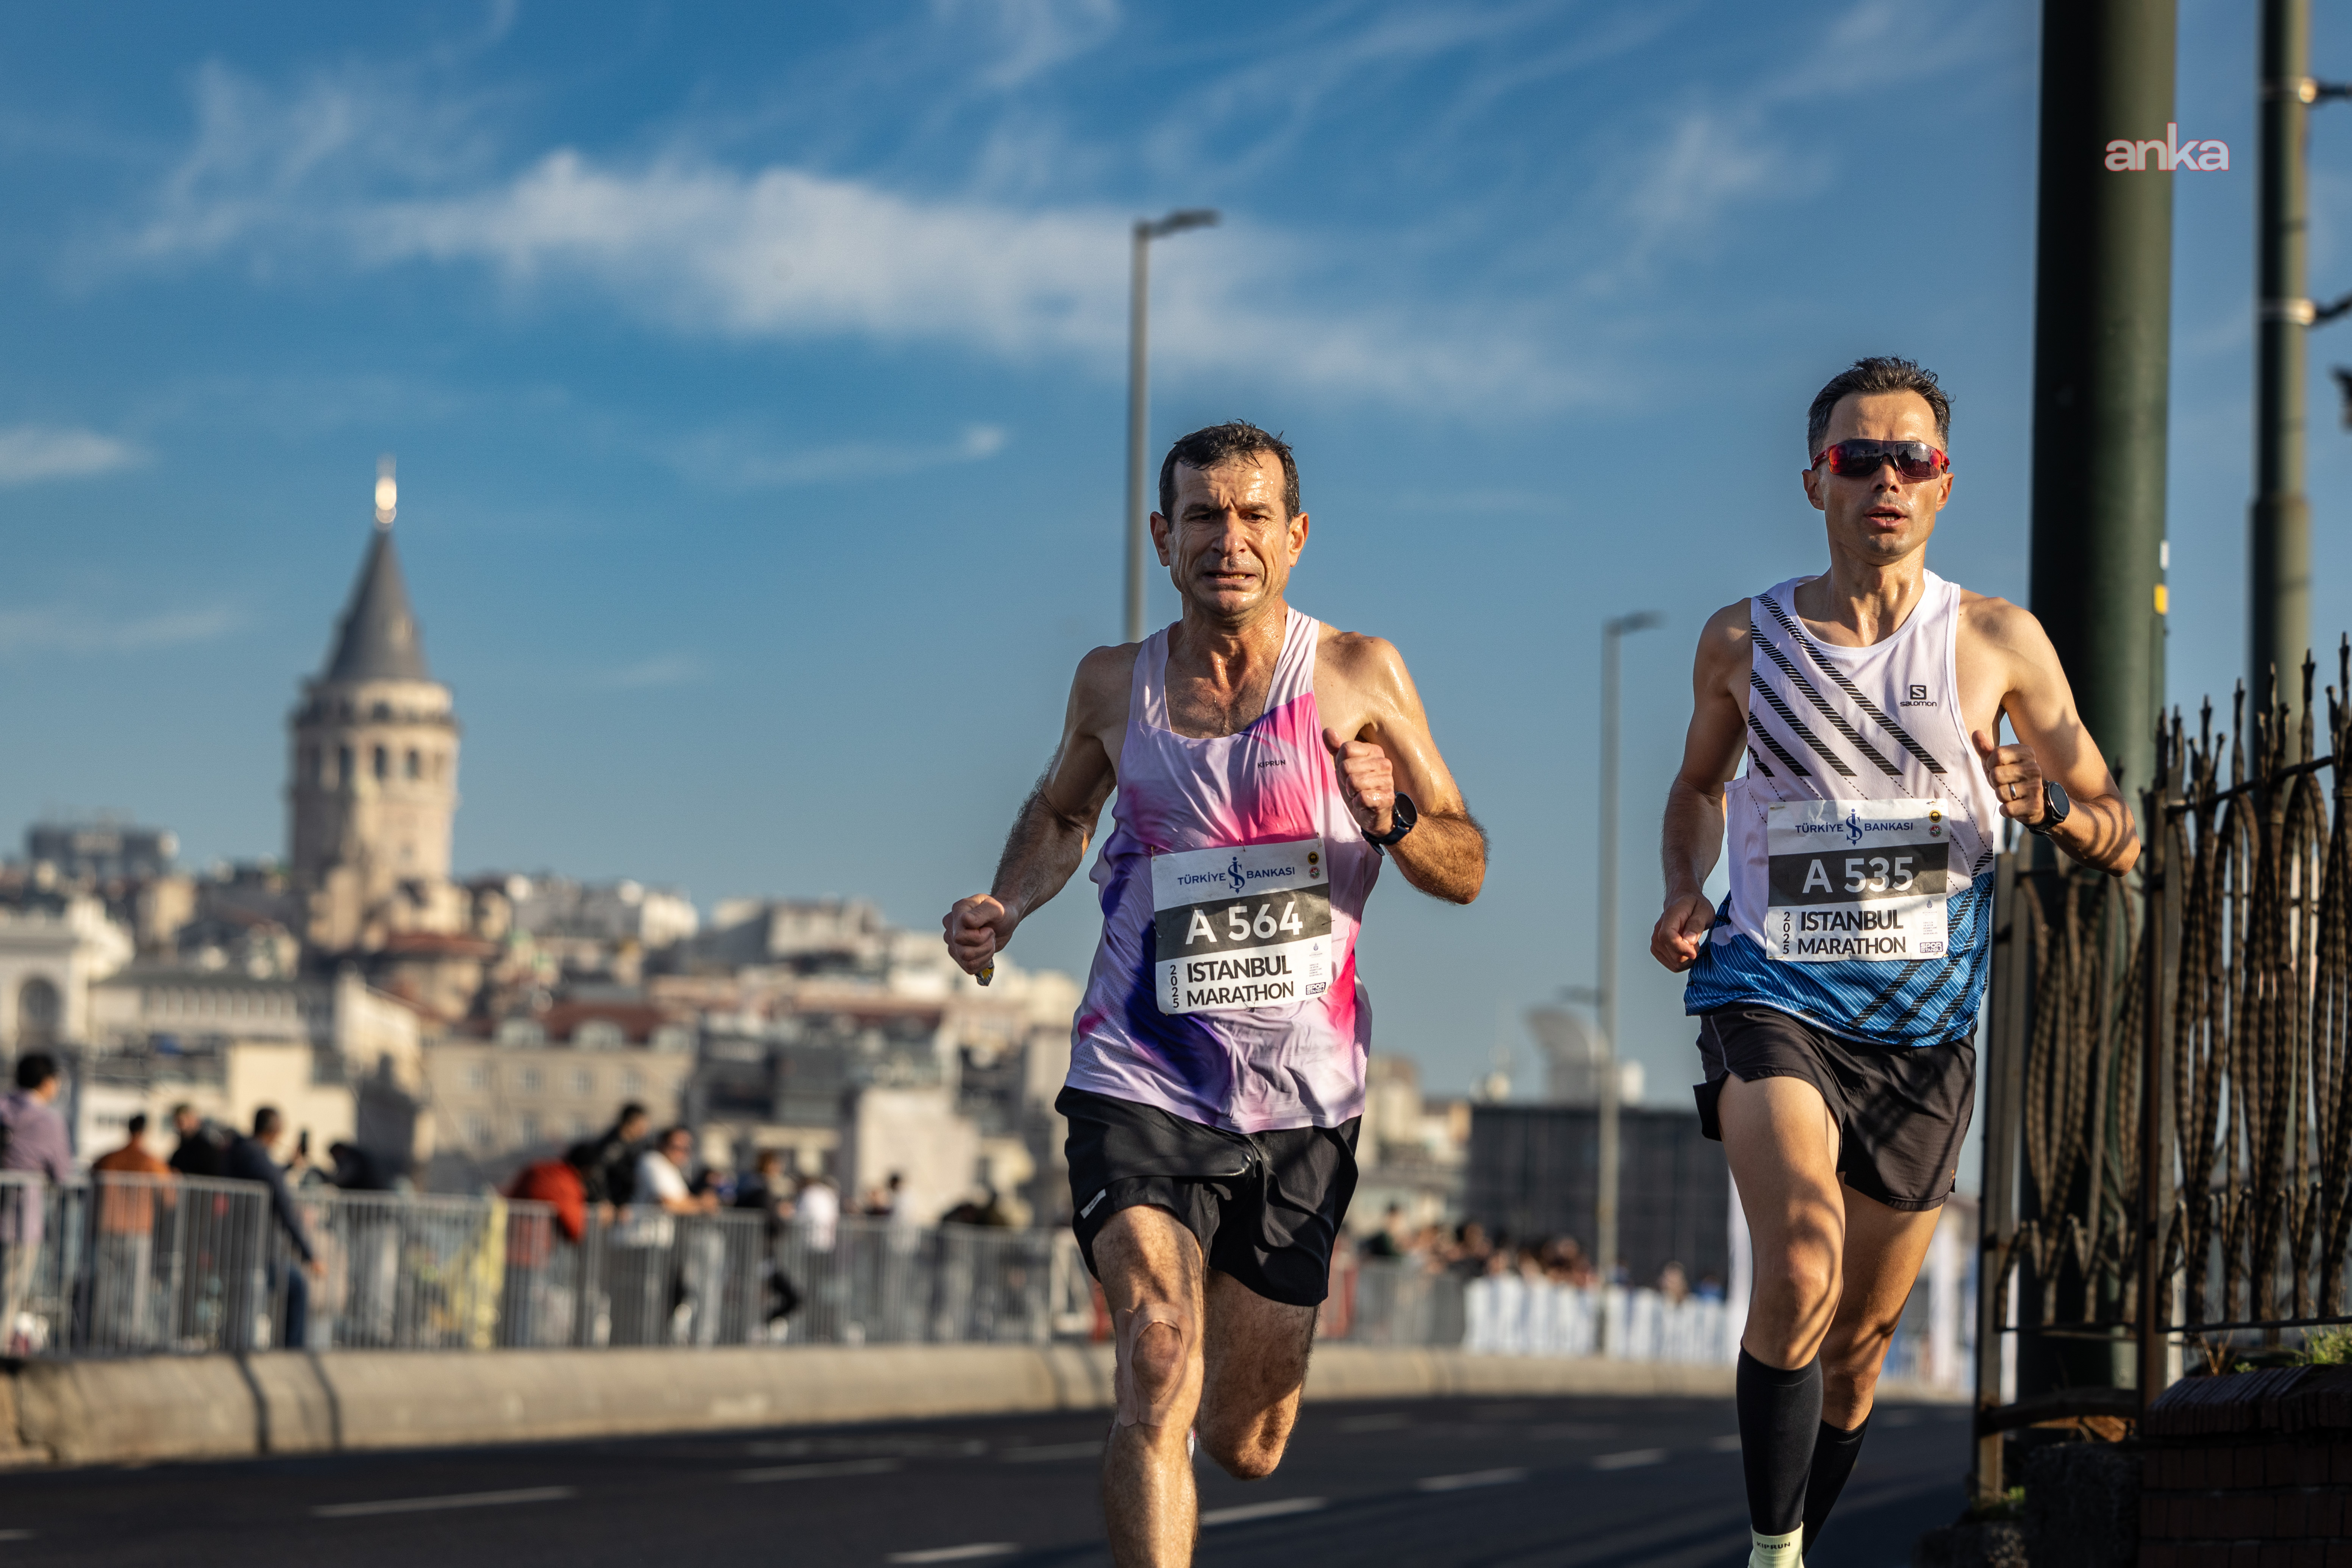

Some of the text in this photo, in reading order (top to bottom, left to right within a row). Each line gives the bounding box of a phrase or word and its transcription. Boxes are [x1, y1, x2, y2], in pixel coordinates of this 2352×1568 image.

[1257, 760, 1286, 768] KIPRUN
[1795, 822, 1843, 833] TÜRKİYE
[1864, 822, 1913, 832] BANKASI
[1177, 871, 1226, 886] TÜRKİYE
[1246, 867, 1295, 880] BANKASI
[1802, 857, 1913, 894] A 535
[1185, 901, 1303, 945] A 564
[1800, 909, 1904, 931] ISTANBUL
[1797, 936, 1906, 955] MARATHON
[1186, 955, 1292, 983] ISTANBUL
[1187, 981, 1294, 1007] MARATHON
[1306, 983, 1325, 991] SPOR
[1756, 1541, 1790, 1549] KIPRUN
